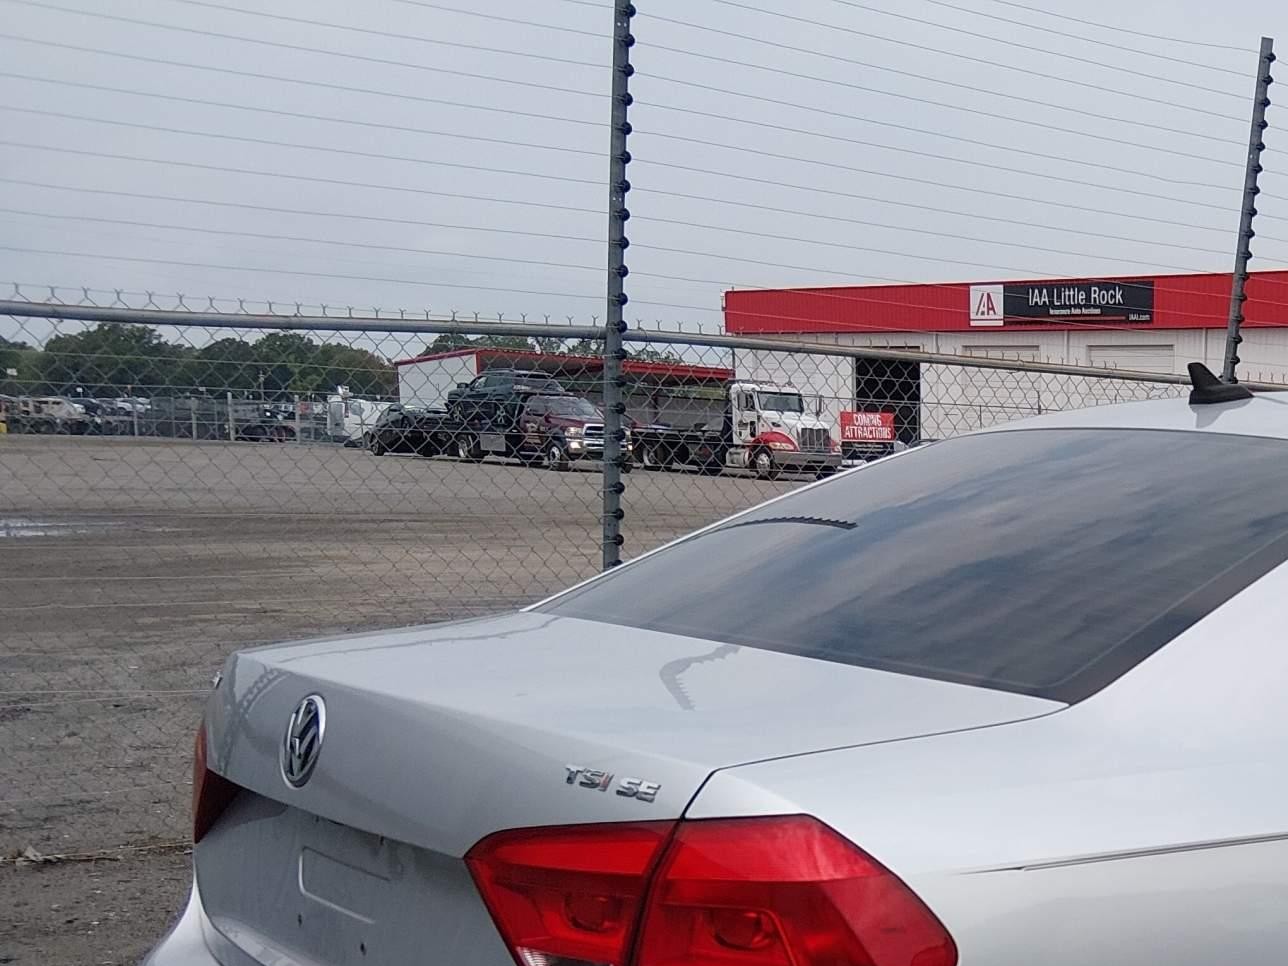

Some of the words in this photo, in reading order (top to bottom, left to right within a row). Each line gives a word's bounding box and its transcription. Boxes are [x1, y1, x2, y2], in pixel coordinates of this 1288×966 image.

[1028, 288, 1049, 306] IAA
[1054, 287, 1086, 305] Little
[1091, 286, 1124, 305] Rock
[844, 425, 892, 439] ATTRACTIONS
[565, 764, 615, 792] TSI
[616, 777, 662, 803] SE
